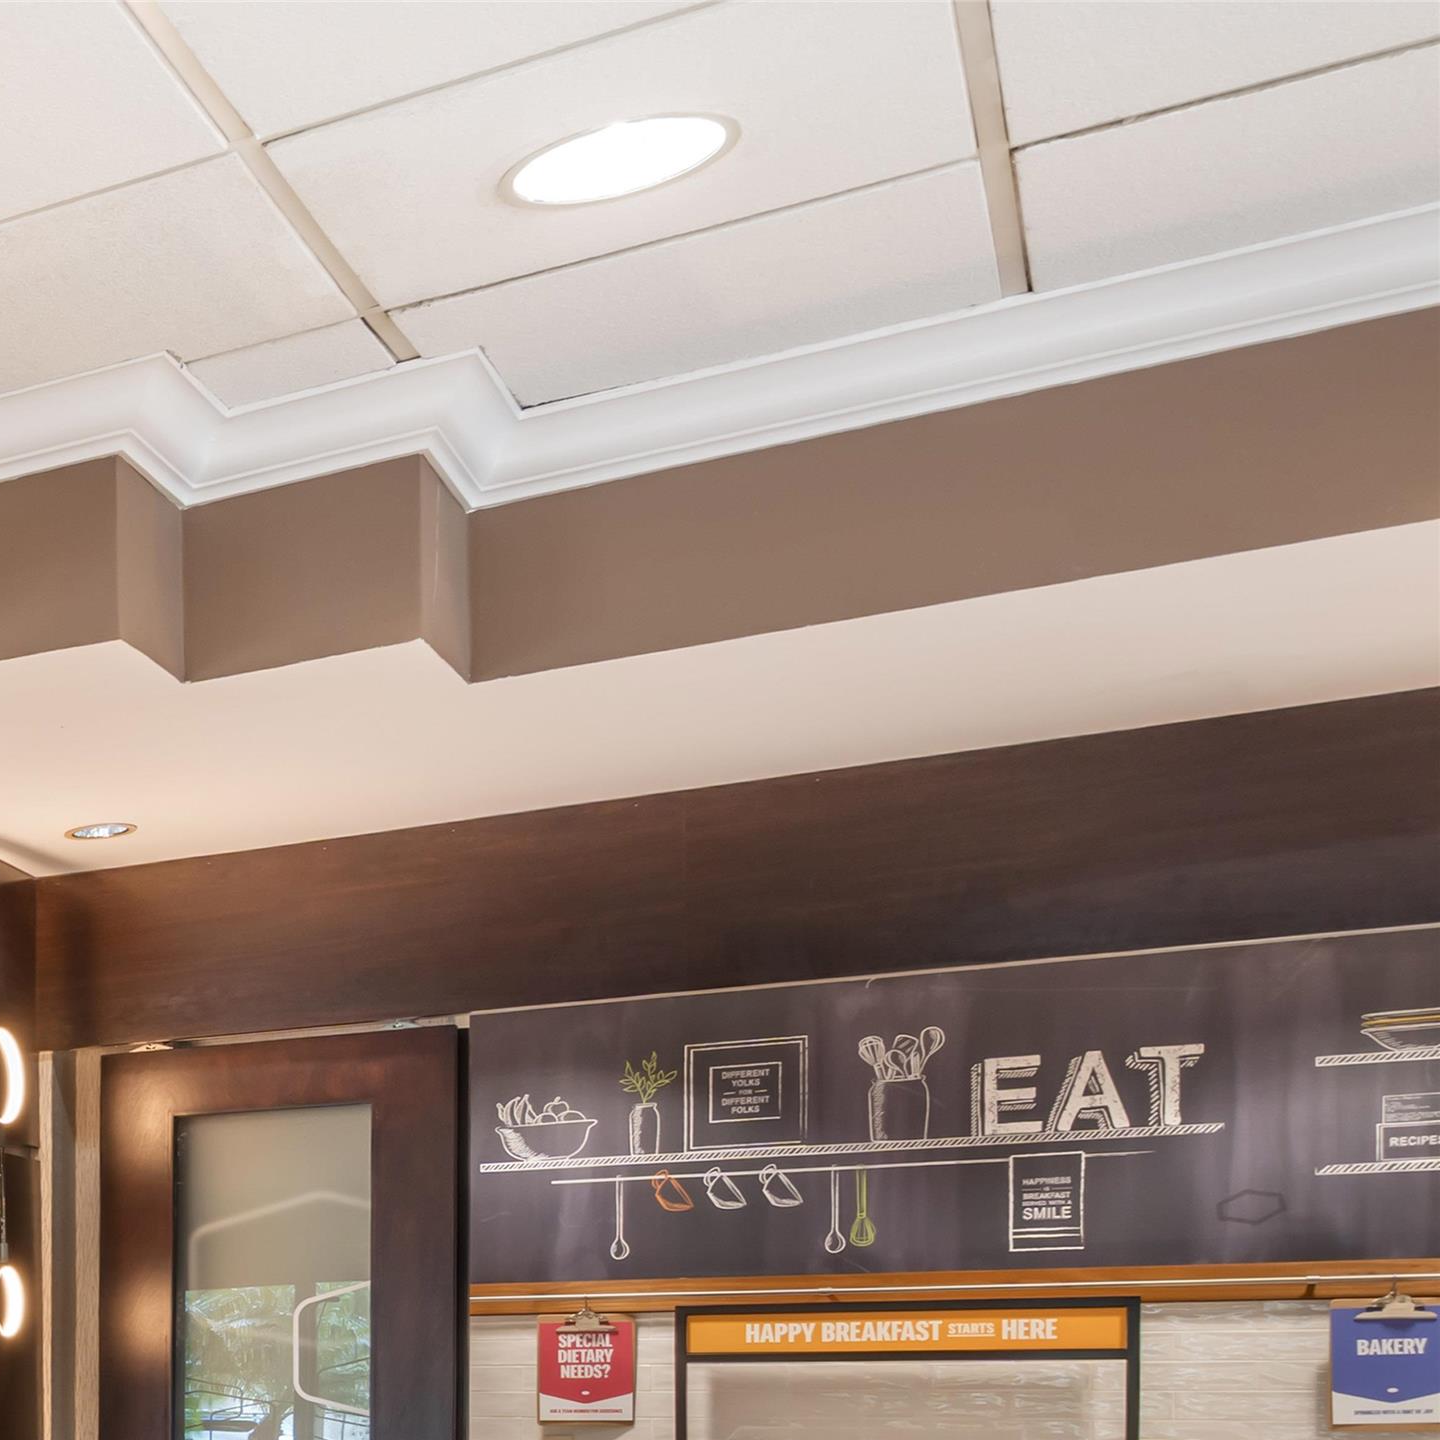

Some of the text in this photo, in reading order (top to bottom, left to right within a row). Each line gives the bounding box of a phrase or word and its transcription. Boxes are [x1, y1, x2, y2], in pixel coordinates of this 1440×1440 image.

[721, 1068, 771, 1079] DIFFERENT
[731, 1078, 761, 1087] YOLKS
[980, 1042, 1206, 1136] EAT
[721, 1095, 770, 1106] DIFFERENT
[731, 1105, 760, 1114] FOLKS
[1388, 1134, 1440, 1147] RECIPE
[1022, 1191, 1072, 1200] BREAKFAST
[1022, 1206, 1072, 1220] SMILE
[745, 1317, 1058, 1344] HAPPY BREAKFAST STARTS HERE
[558, 1333, 613, 1348] SPECIAL
[1356, 1337, 1429, 1356] BAKERY
[557, 1349, 614, 1363] DIETARY
[560, 1364, 611, 1378] NEEDS?
